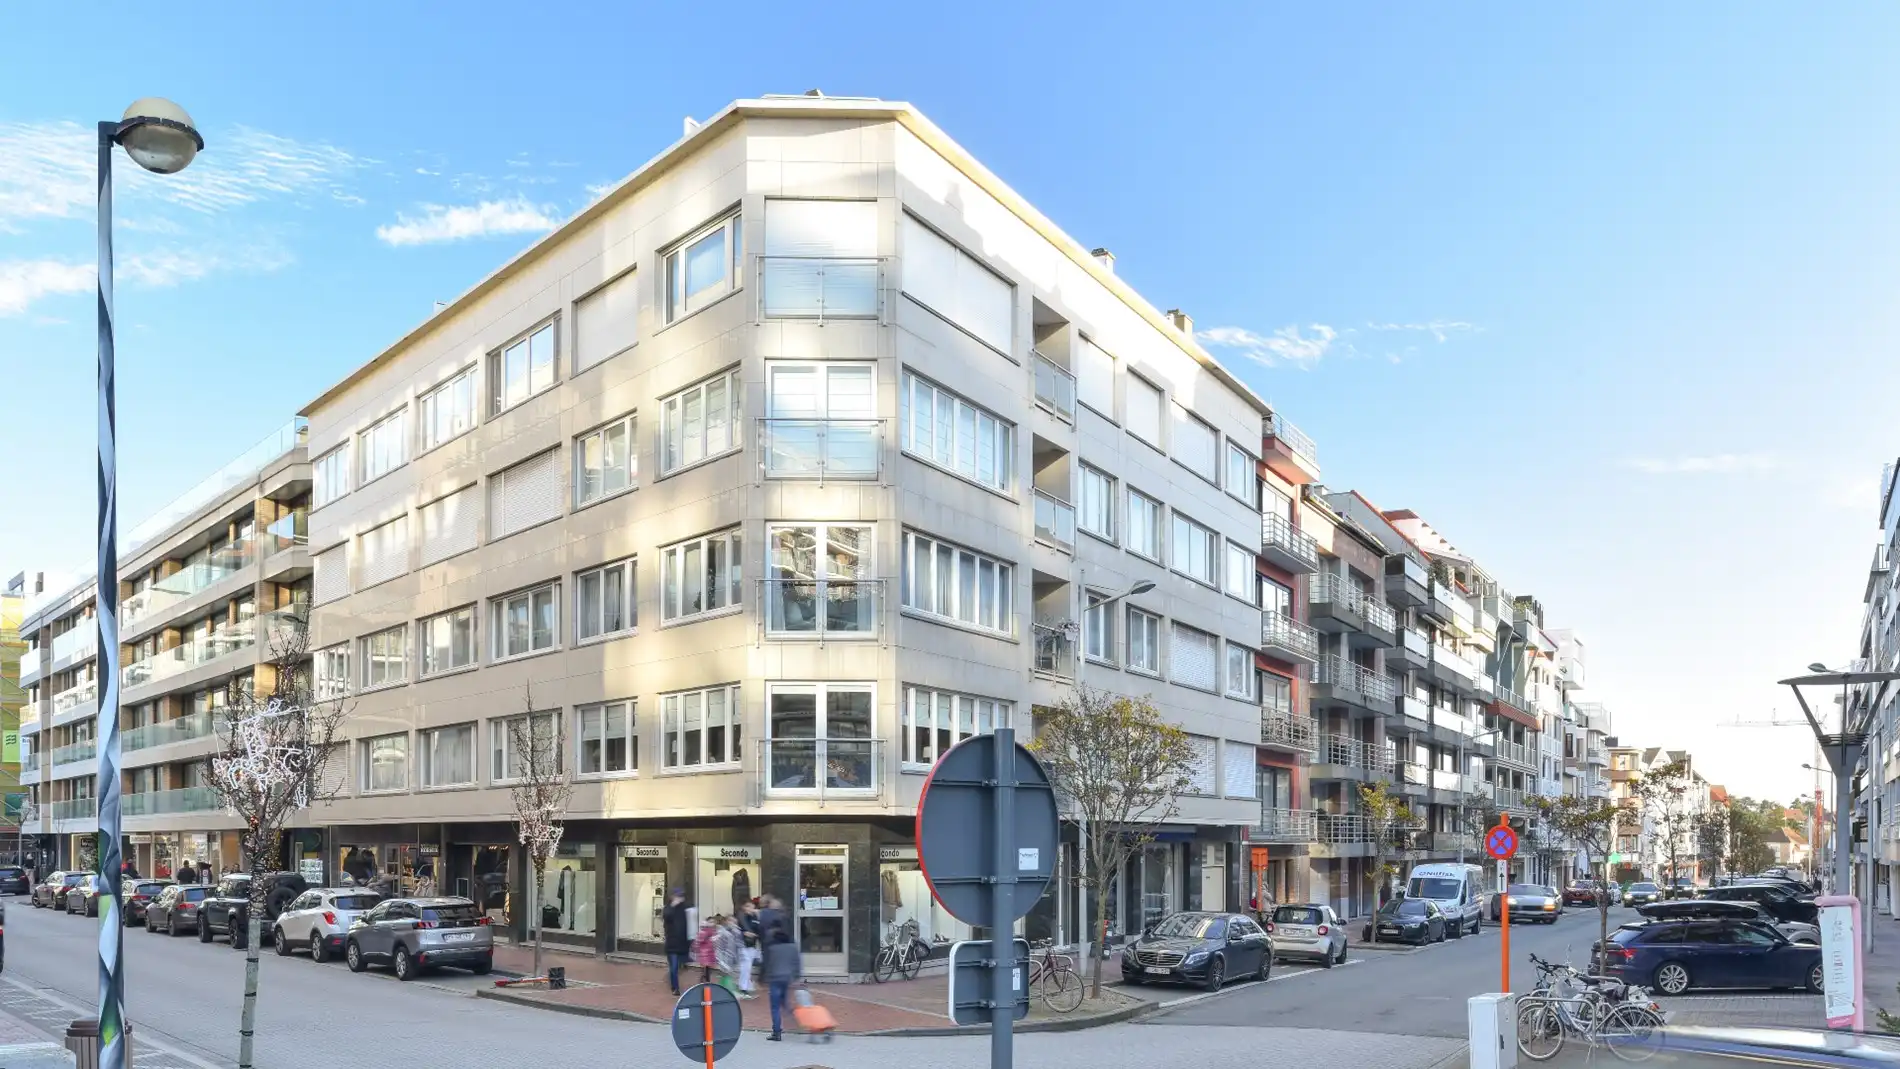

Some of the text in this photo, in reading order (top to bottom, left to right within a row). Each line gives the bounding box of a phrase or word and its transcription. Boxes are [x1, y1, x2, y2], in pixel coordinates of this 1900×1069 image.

[636, 847, 660, 857] Secondo
[720, 847, 749, 858] Secondo
[880, 848, 900, 858] condo
